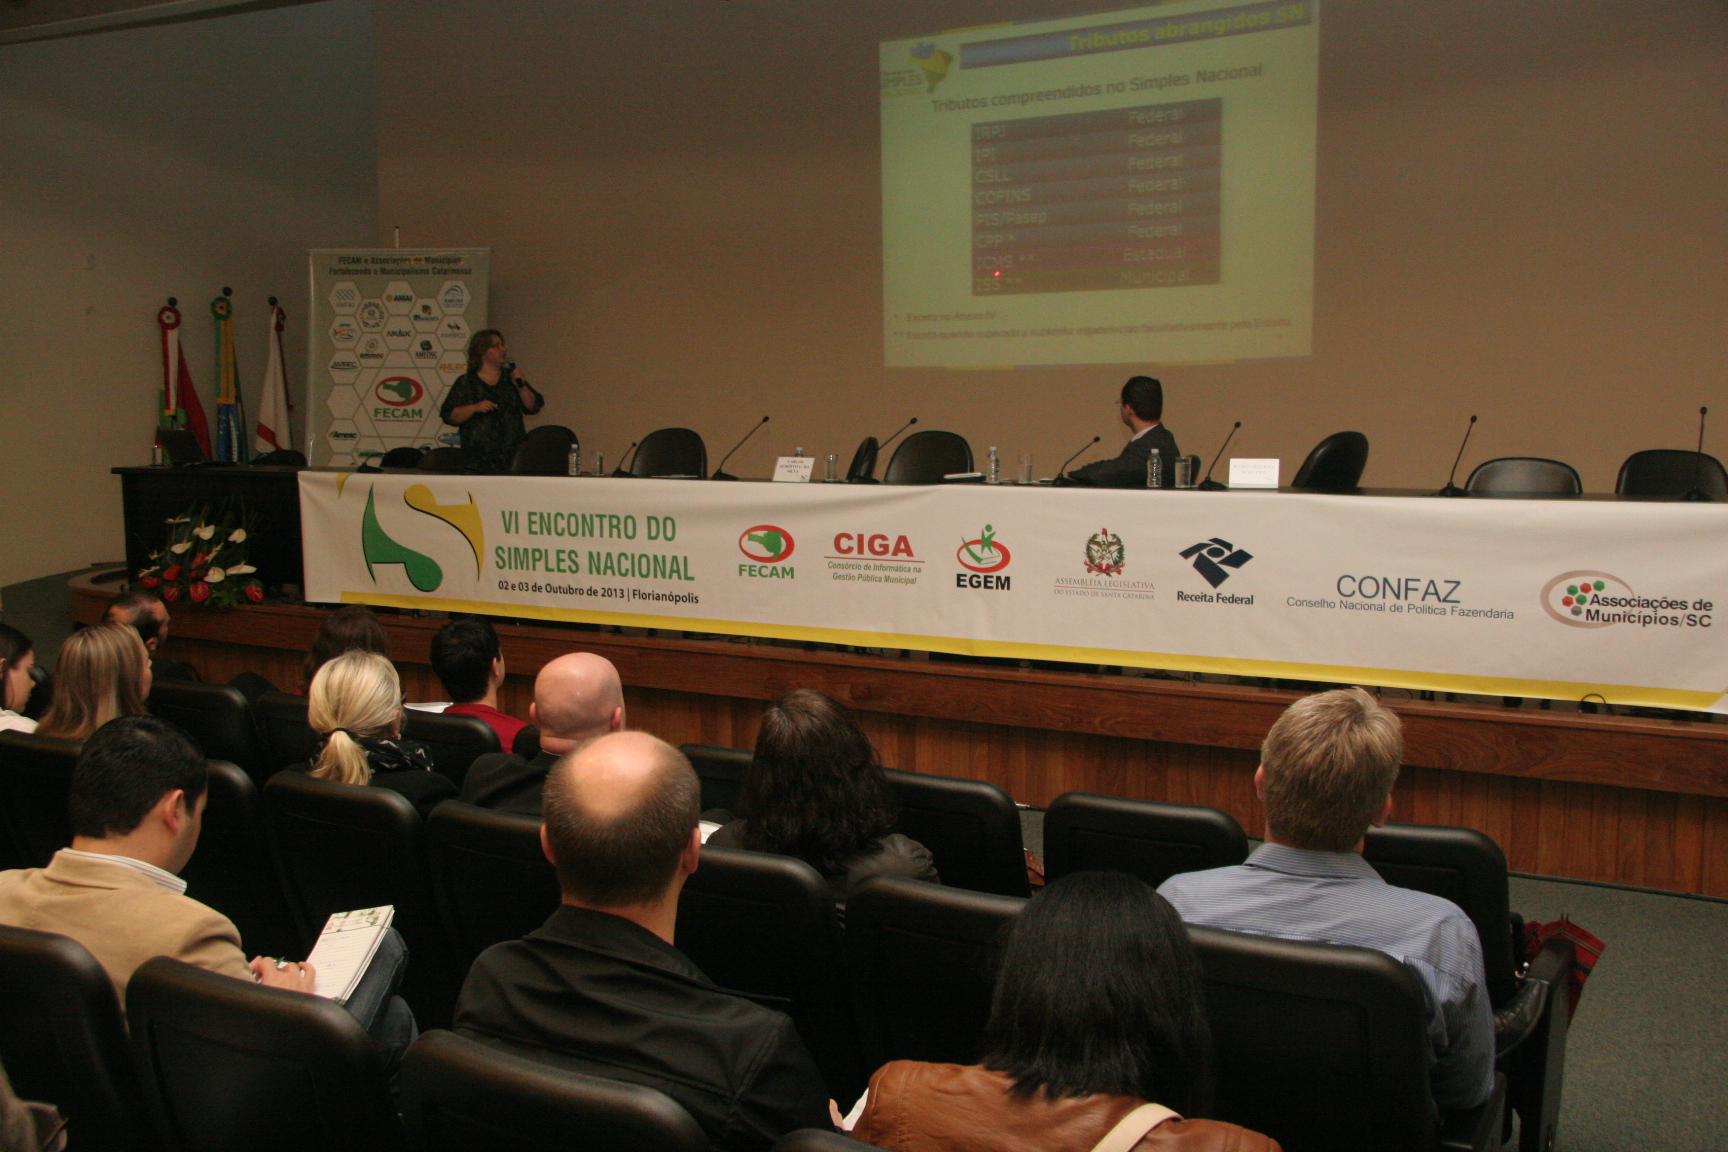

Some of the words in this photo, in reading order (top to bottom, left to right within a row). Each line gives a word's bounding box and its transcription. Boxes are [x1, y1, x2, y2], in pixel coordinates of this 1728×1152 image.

[1068, 27, 1150, 52] Tributos
[1155, 10, 1272, 42] abrangidos
[931, 95, 988, 113] Tributos
[991, 82, 1101, 107] compreendidos
[1106, 81, 1126, 95] no
[1130, 71, 1191, 92] Simples
[1196, 63, 1264, 83] Nacional
[1128, 108, 1183, 124] Federal
[1128, 132, 1183, 148] Federal
[1128, 155, 1183, 171] Federal
[1128, 178, 1183, 194] Federal
[975, 188, 1031, 205] COFINS
[1128, 201, 1183, 216] Federal
[1128, 223, 1183, 239] Federal
[374, 408, 423, 419] FECAM
[501, 510, 519, 535] VI
[527, 511, 637, 540] ENCONTRO
[646, 515, 677, 542] DO
[833, 532, 914, 558] CIGA
[495, 545, 580, 575] SIMPLES
[588, 550, 695, 581] NACIONAL
[828, 561, 862, 571] Consórcio
[863, 562, 872, 571] de
[873, 562, 912, 574] Informática
[913, 566, 922, 574] na
[738, 564, 795, 580] FECAM
[832, 572, 856, 582] Gestão
[857, 572, 882, 583] Pública
[884, 575, 917, 586] Municipal
[956, 573, 1011, 591] EGEM
[1104, 579, 1155, 590] LEGISLATIVA
[1336, 574, 1461, 604] CONFAZ
[498, 580, 509, 591] 02
[511, 583, 517, 592] e
[518, 582, 530, 592] 03
[531, 582, 543, 593] de
[545, 583, 585, 596] Outubro
[586, 585, 599, 597] de
[601, 587, 625, 599] 2013
[632, 589, 699, 605] Florianópolis
[1065, 589, 1089, 597] ESTADO
[1101, 590, 1121, 598] SANTA
[1122, 592, 1155, 600] CATARINA
[1177, 590, 1214, 603] Receita
[1216, 592, 1254, 605] Federal
[1286, 596, 1336, 609] Conselho
[1339, 599, 1386, 612] Nacional
[1389, 603, 1403, 613] de
[1589, 593, 1689, 613] Associações
[1692, 598, 1713, 612] de
[1585, 608, 1713, 628] Municípios/SC
